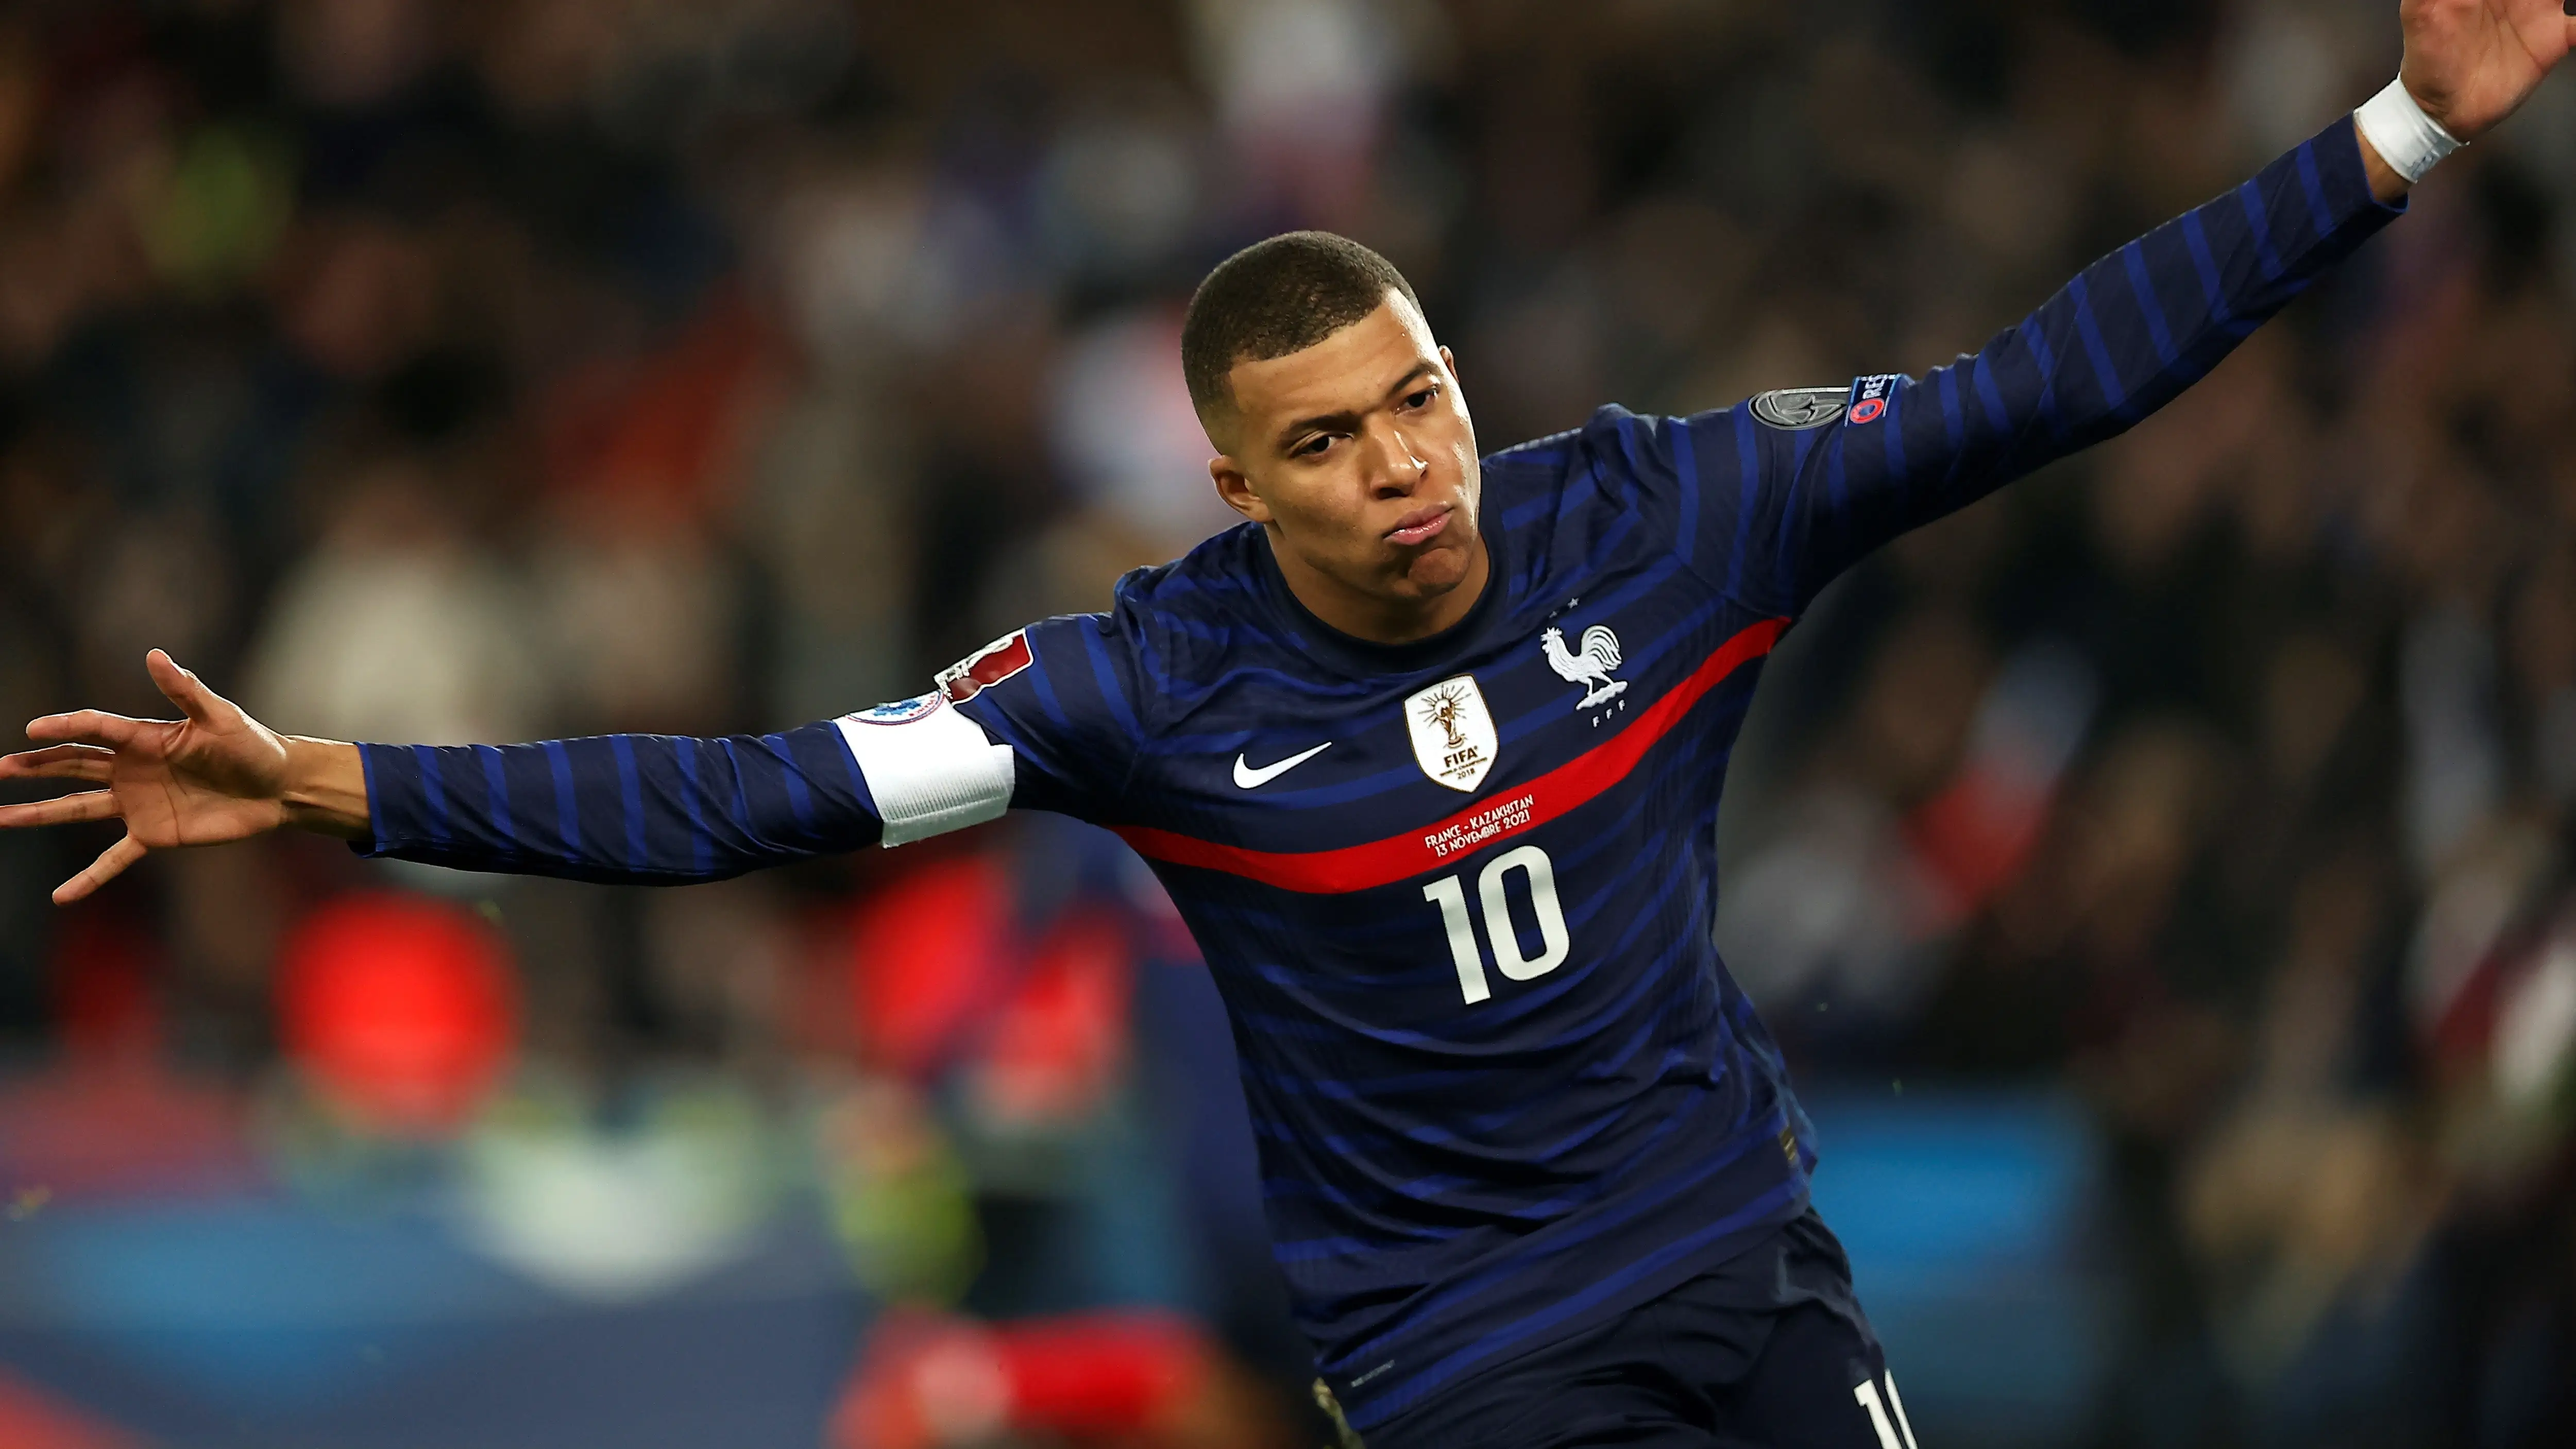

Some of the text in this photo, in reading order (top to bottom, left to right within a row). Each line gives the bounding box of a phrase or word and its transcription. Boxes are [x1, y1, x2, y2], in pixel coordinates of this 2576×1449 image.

[1444, 747, 1478, 768] FIFA
[1425, 824, 1461, 848] FRANCE
[1469, 794, 1534, 829] KAZAKHSTAN
[1434, 809, 1530, 857] 13 NOVEMBRE 2021
[1422, 845, 1569, 1004] 10
